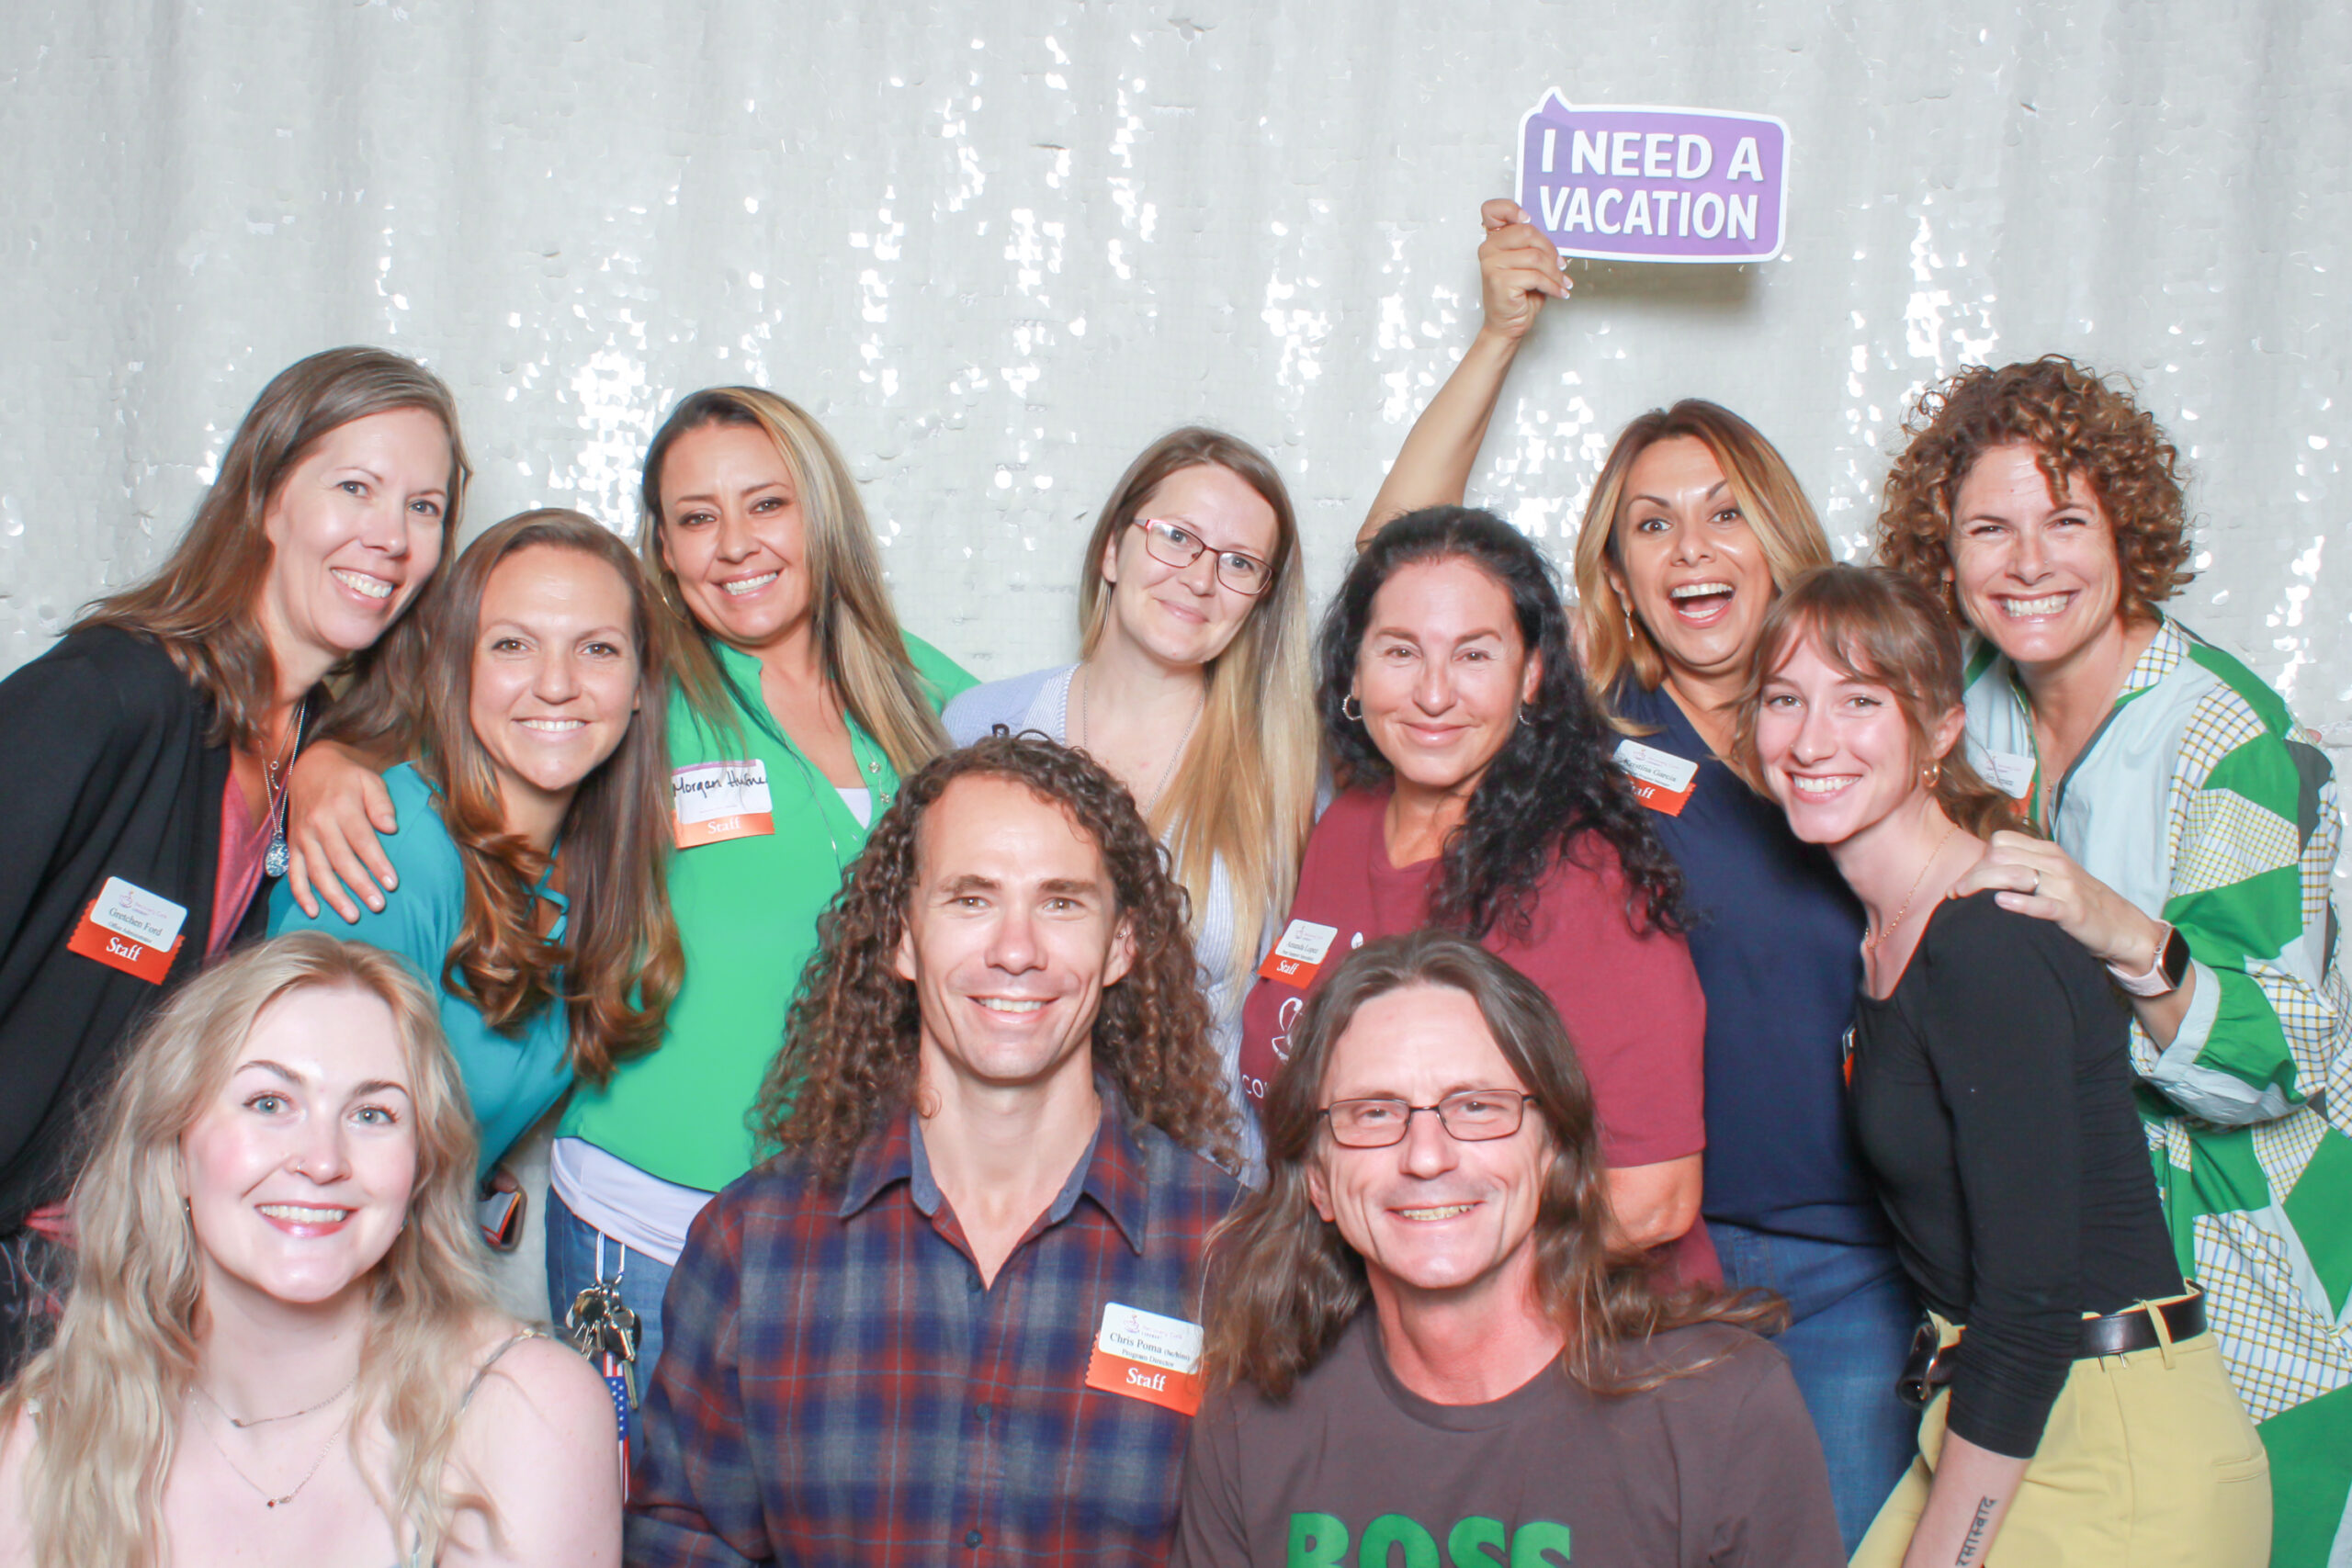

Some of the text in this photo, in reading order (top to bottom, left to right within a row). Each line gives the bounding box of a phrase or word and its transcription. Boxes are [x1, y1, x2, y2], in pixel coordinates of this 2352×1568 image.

[1542, 129, 1764, 181] I NEED A
[1540, 186, 1758, 240] VACATION
[673, 776, 722, 798] Morgan
[707, 817, 741, 834] Staff
[108, 907, 142, 928] Gretchen
[143, 921, 164, 936] Ford
[106, 936, 143, 962] Staff
[1276, 960, 1300, 975] Staff
[1242, 1074, 1268, 1099] CO
[1110, 1332, 1134, 1347] Chris
[1137, 1339, 1162, 1353] Poma
[1126, 1367, 1167, 1392] Staff
